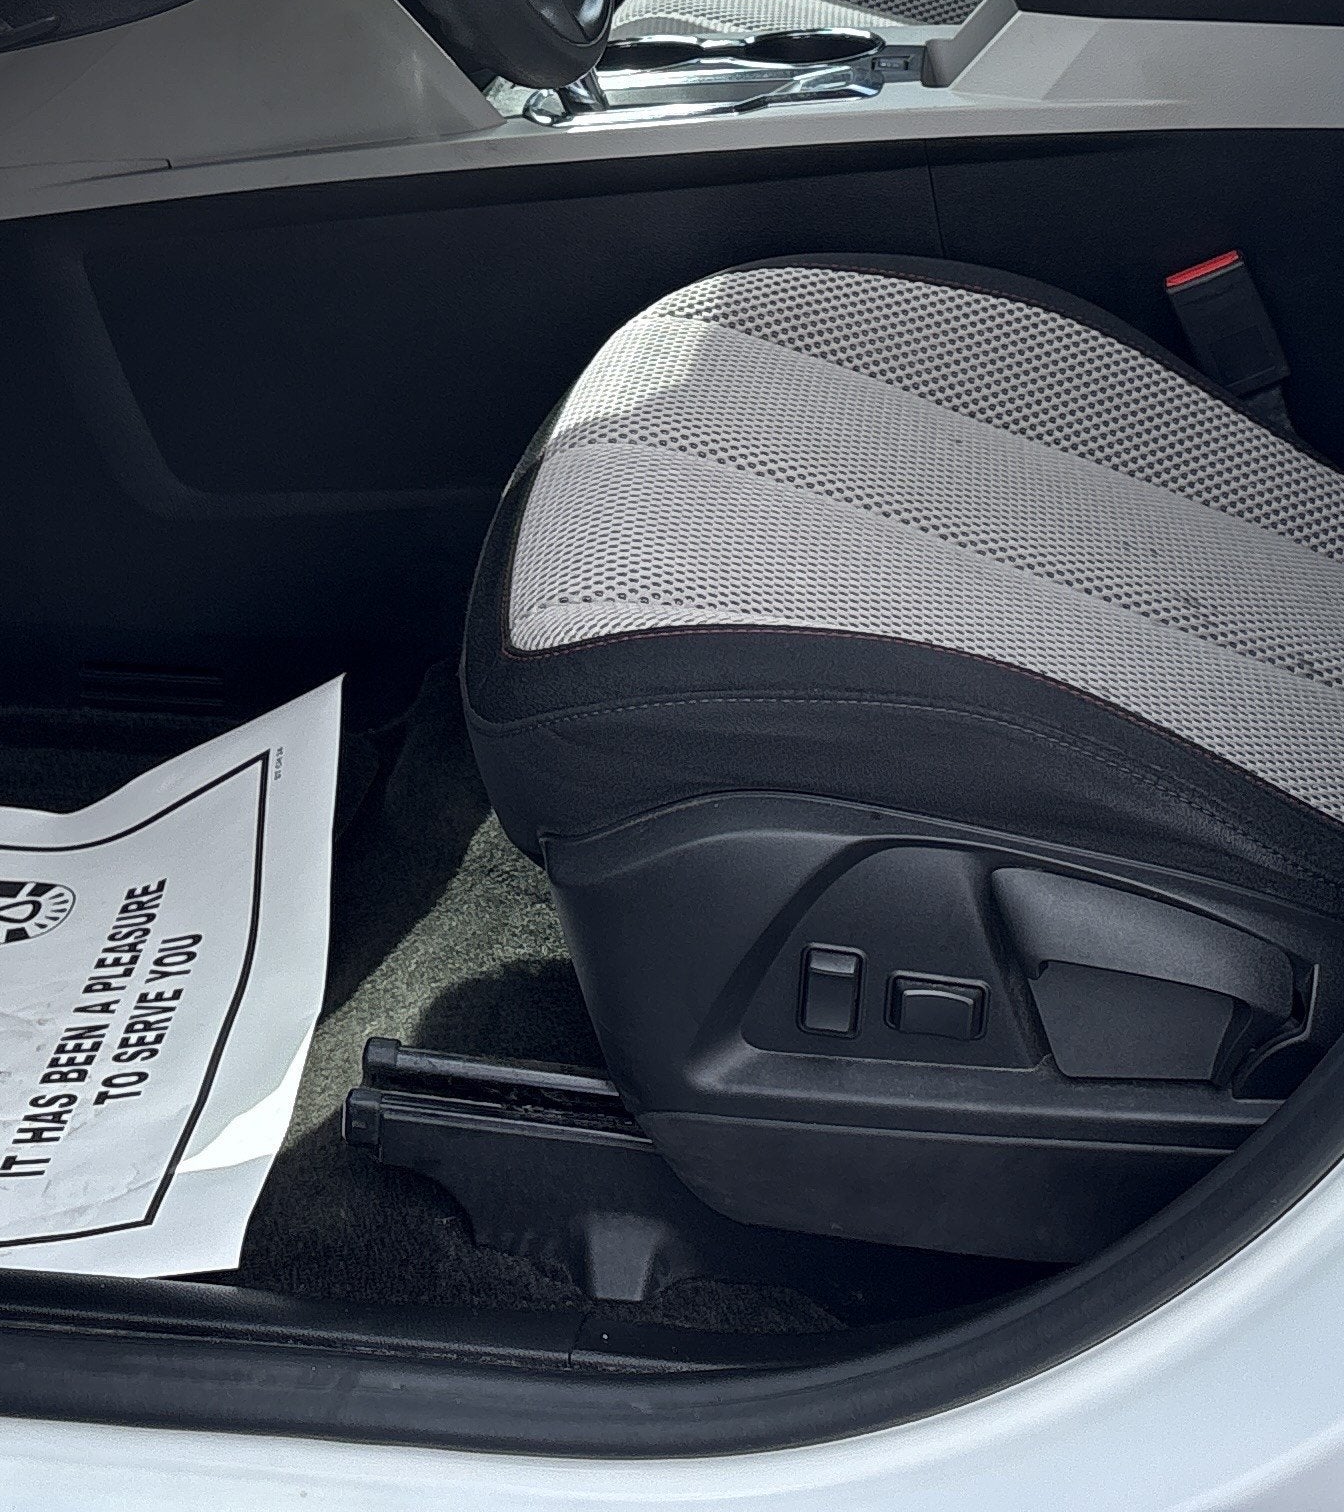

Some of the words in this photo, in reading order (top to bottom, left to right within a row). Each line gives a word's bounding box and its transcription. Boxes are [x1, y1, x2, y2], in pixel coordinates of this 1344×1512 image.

[82, 877, 168, 995] PLEASURE
[145, 933, 203, 984] YOU
[72, 998, 122, 1014] A
[112, 988, 185, 1063] SERVE
[39, 1023, 110, 1085] BEEN
[93, 1071, 150, 1106] TO
[11, 1092, 78, 1145] HAS
